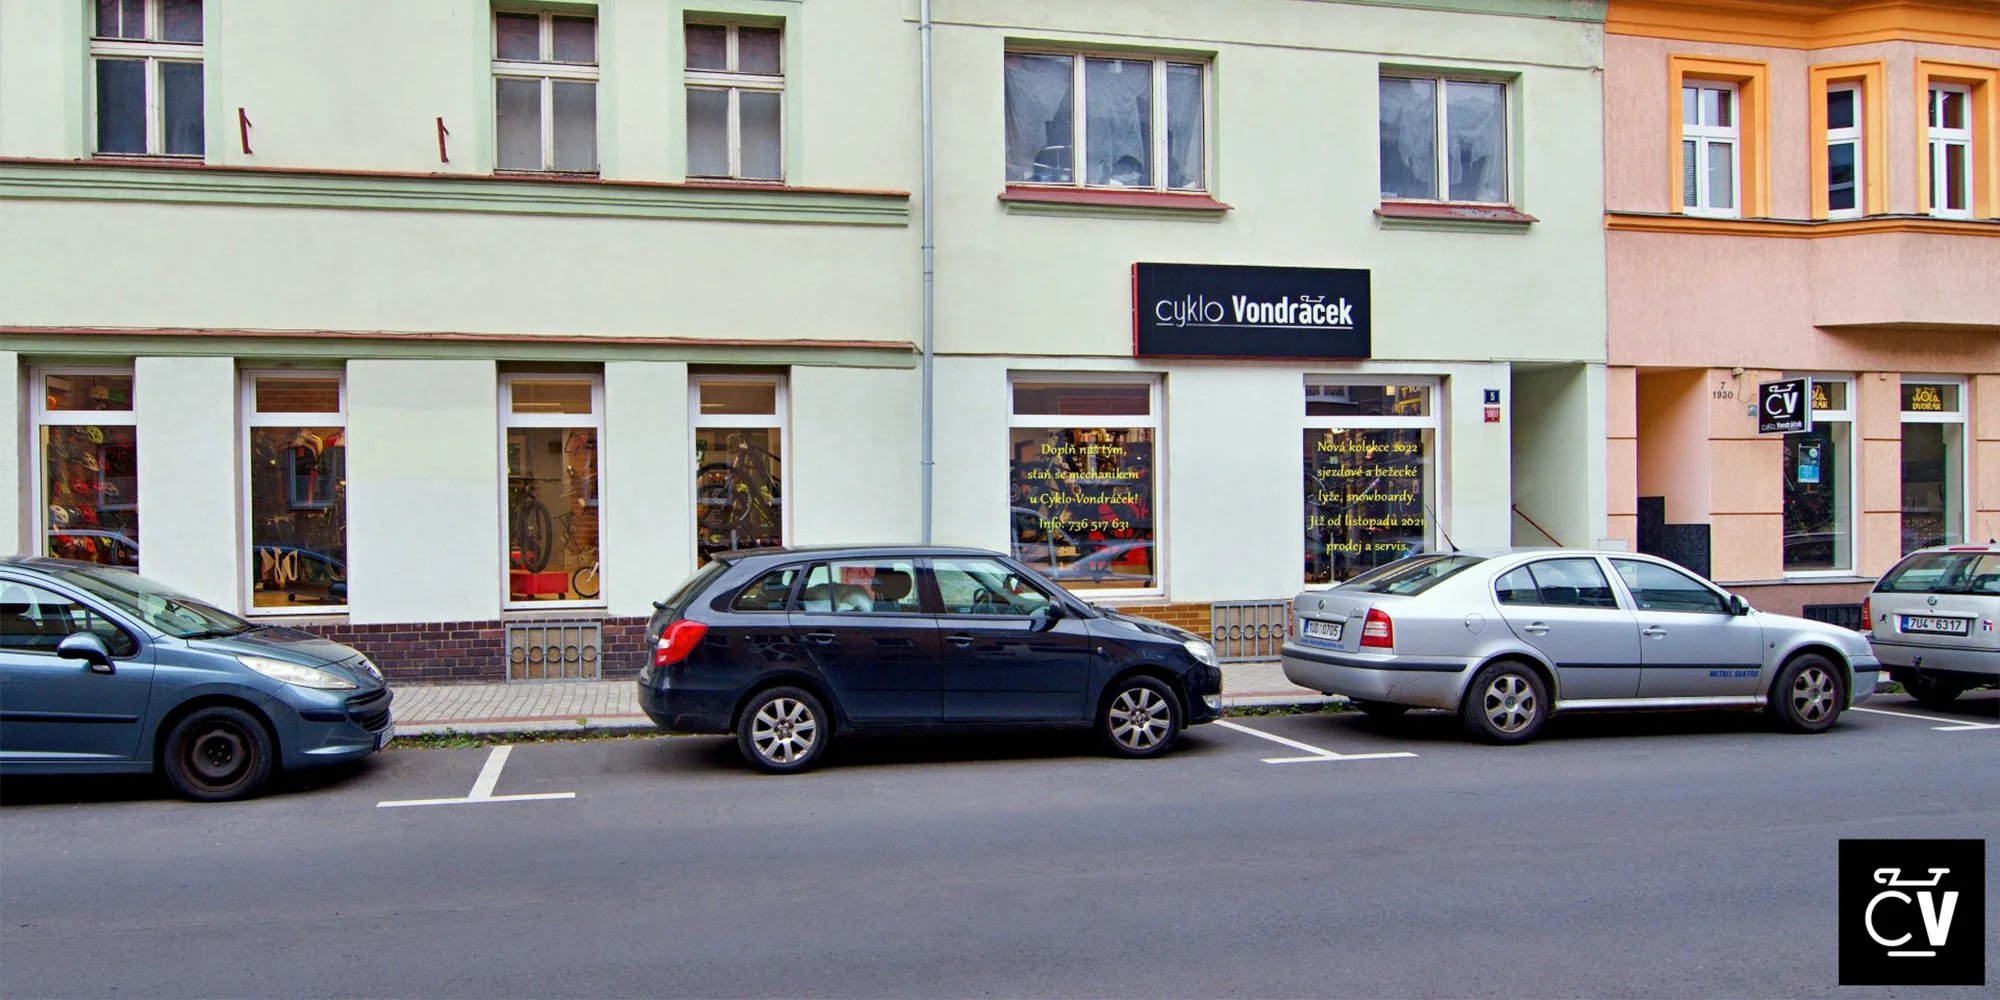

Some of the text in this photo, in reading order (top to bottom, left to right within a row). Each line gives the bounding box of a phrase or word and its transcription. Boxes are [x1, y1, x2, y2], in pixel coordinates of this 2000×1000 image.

[1156, 294, 1225, 327] cyklo
[1721, 381, 1726, 390] 7
[1490, 392, 1495, 401] 5
[1712, 390, 1734, 399] 1930
[1041, 442, 1127, 458] Doplň náš tým,
[1317, 440, 1418, 452] Nová kolekce 2022
[1027, 467, 1139, 479] staň se mechanikem
[1317, 465, 1363, 480] sjezdové
[1365, 469, 1372, 477] a
[1029, 492, 1138, 508] u Cyklo Vondráček!
[1318, 489, 1416, 506] lyže, snowboardy.
[1040, 516, 1129, 532] Info: 736 517 631
[1308, 515, 1325, 530] Již
[1327, 515, 1341, 526] od
[1345, 514, 1398, 529] listopadu
[1326, 539, 1410, 555] prodej a servis.
[1322, 623, 1339, 636] 0705
[1910, 618, 1962, 631] 7U4 6317
[1734, 670, 1759, 678] QUATRO
